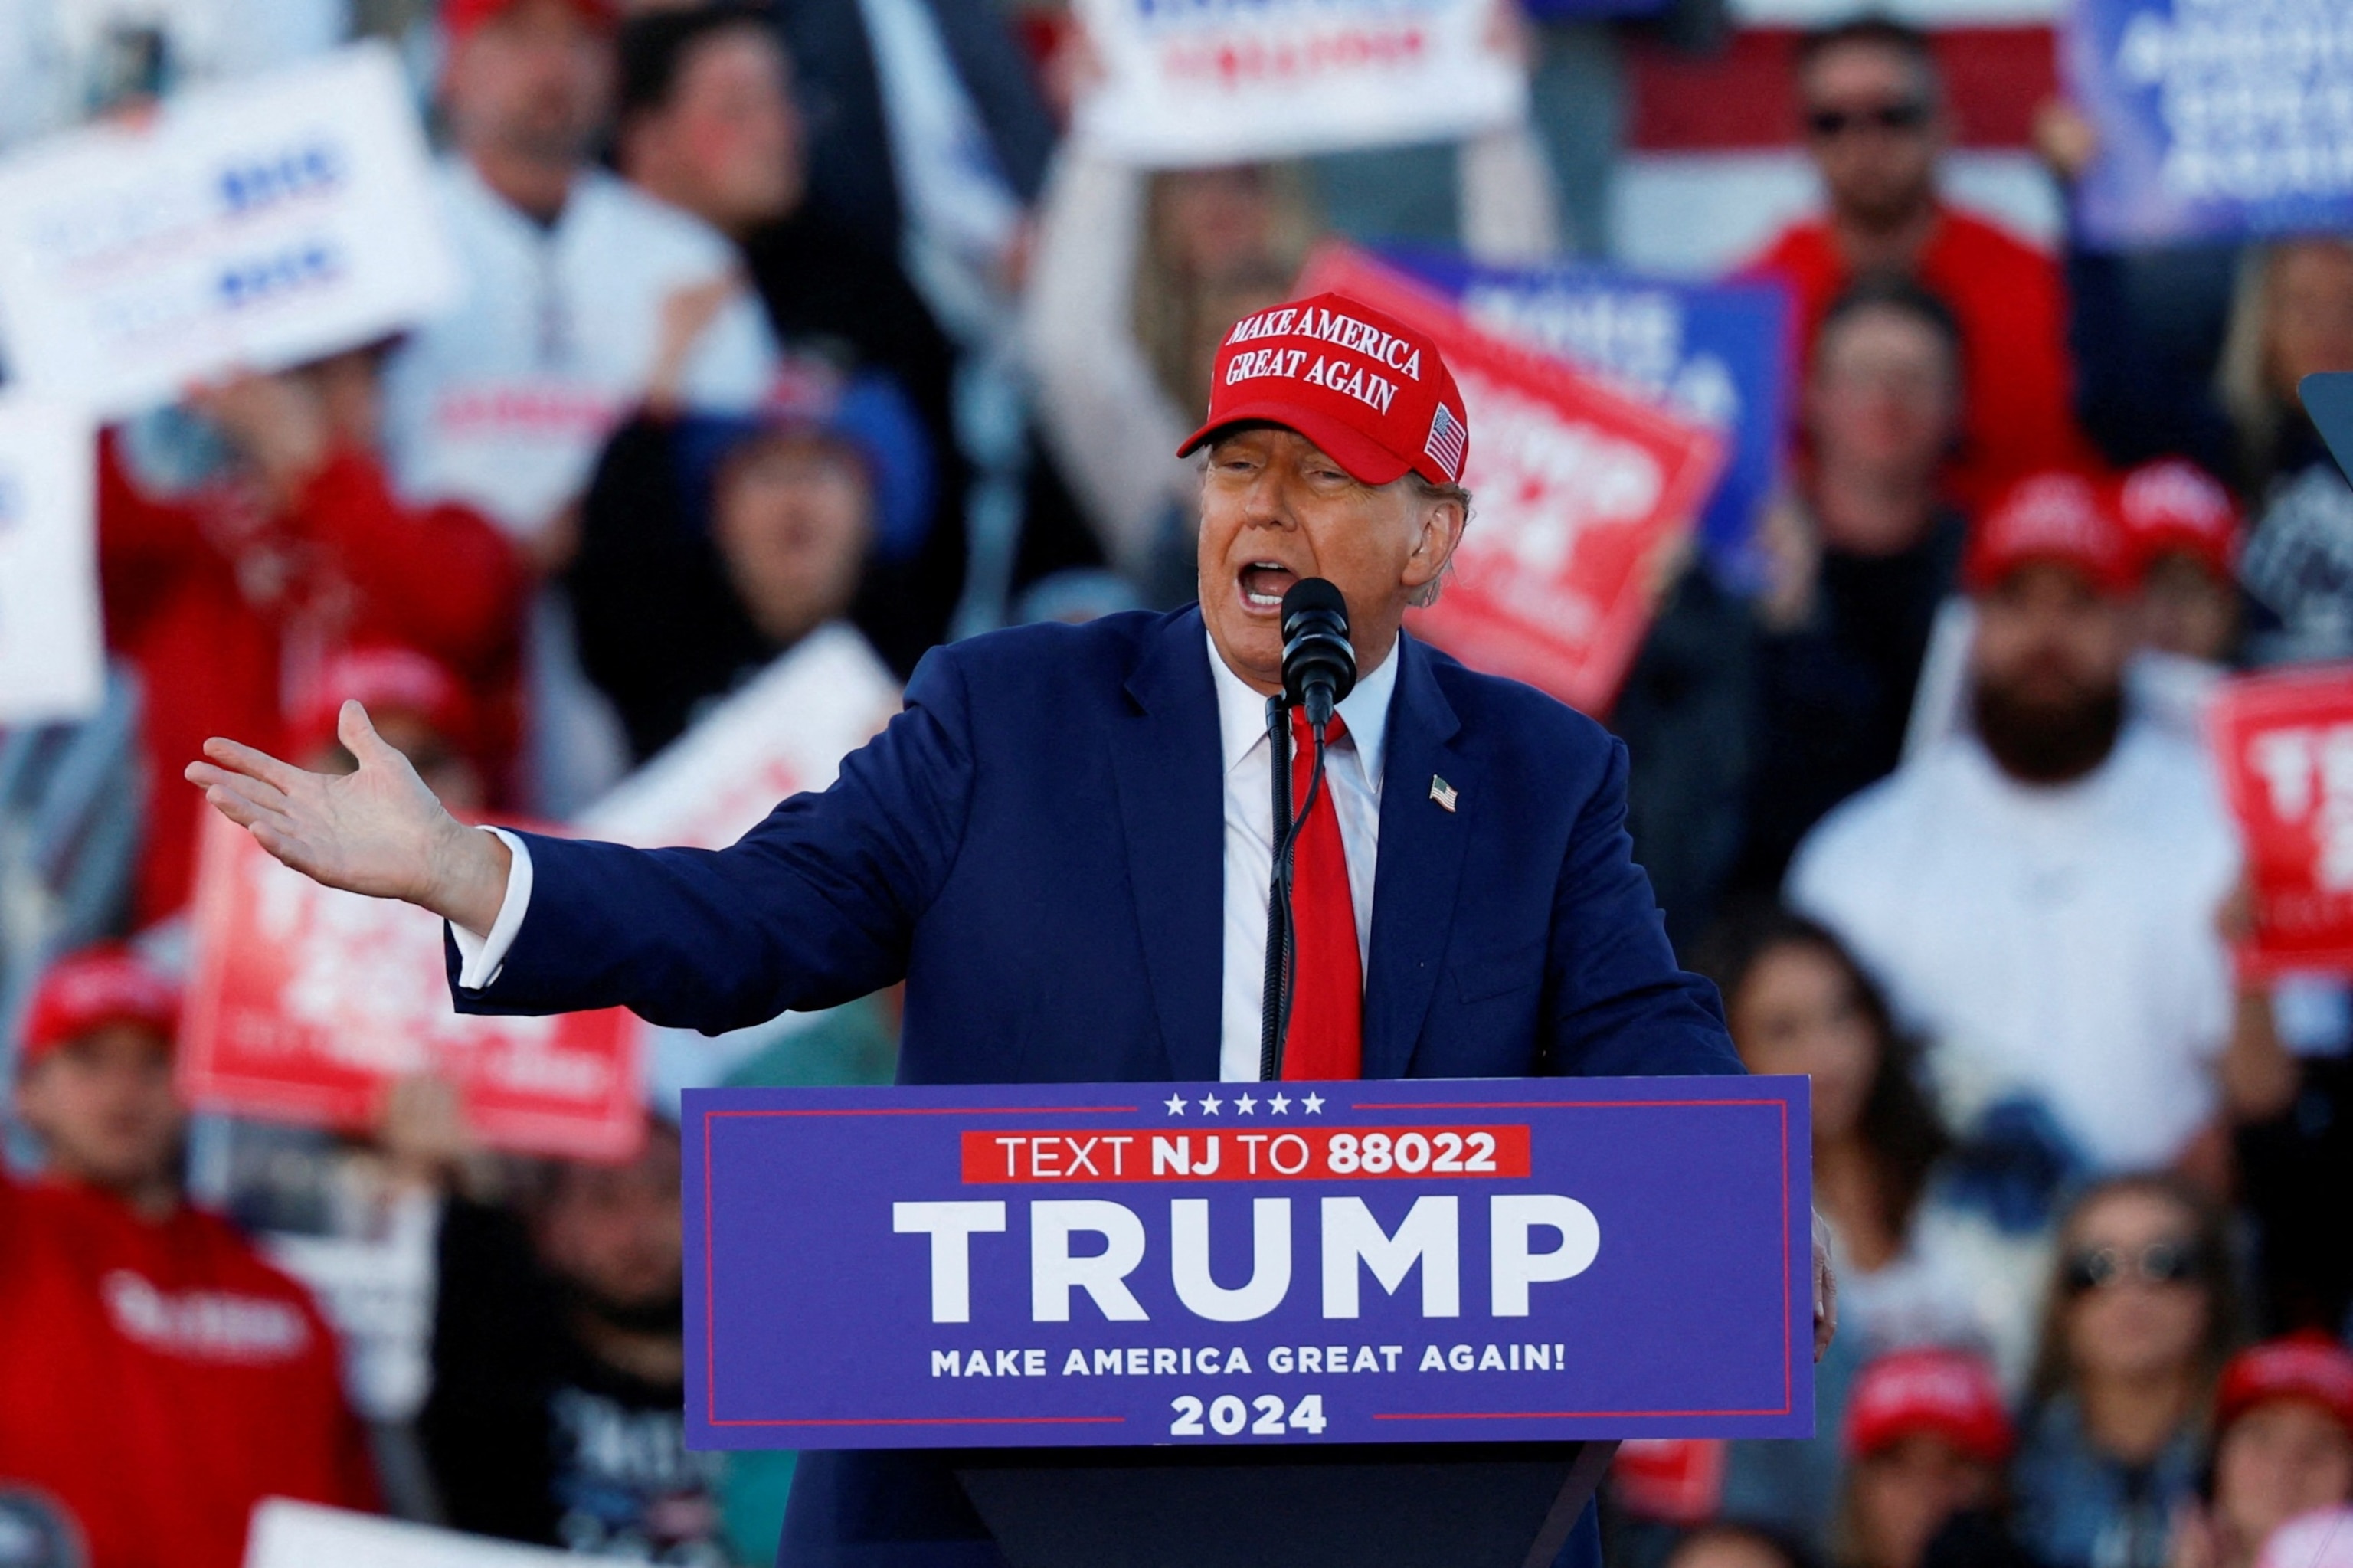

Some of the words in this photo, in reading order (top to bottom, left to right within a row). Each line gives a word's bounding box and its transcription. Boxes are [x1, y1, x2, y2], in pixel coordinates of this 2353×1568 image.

[1225, 308, 1298, 346] MAKE
[1292, 306, 1421, 382] AMERICA
[1226, 348, 1307, 386] GREAT
[1303, 355, 1399, 416] AGAIN
[995, 1136, 1134, 1177] TEXT
[1152, 1135, 1219, 1176] NJ
[1236, 1134, 1309, 1174] TO
[1327, 1131, 1497, 1174] 88022
[893, 1194, 1600, 1323] TRUMP
[931, 1349, 1046, 1377] MAKE
[1062, 1347, 1252, 1376] AMERICA
[1268, 1345, 1403, 1374] GREAT
[1419, 1344, 1565, 1372] AGAIN!
[1170, 1394, 1327, 1435] 2024
